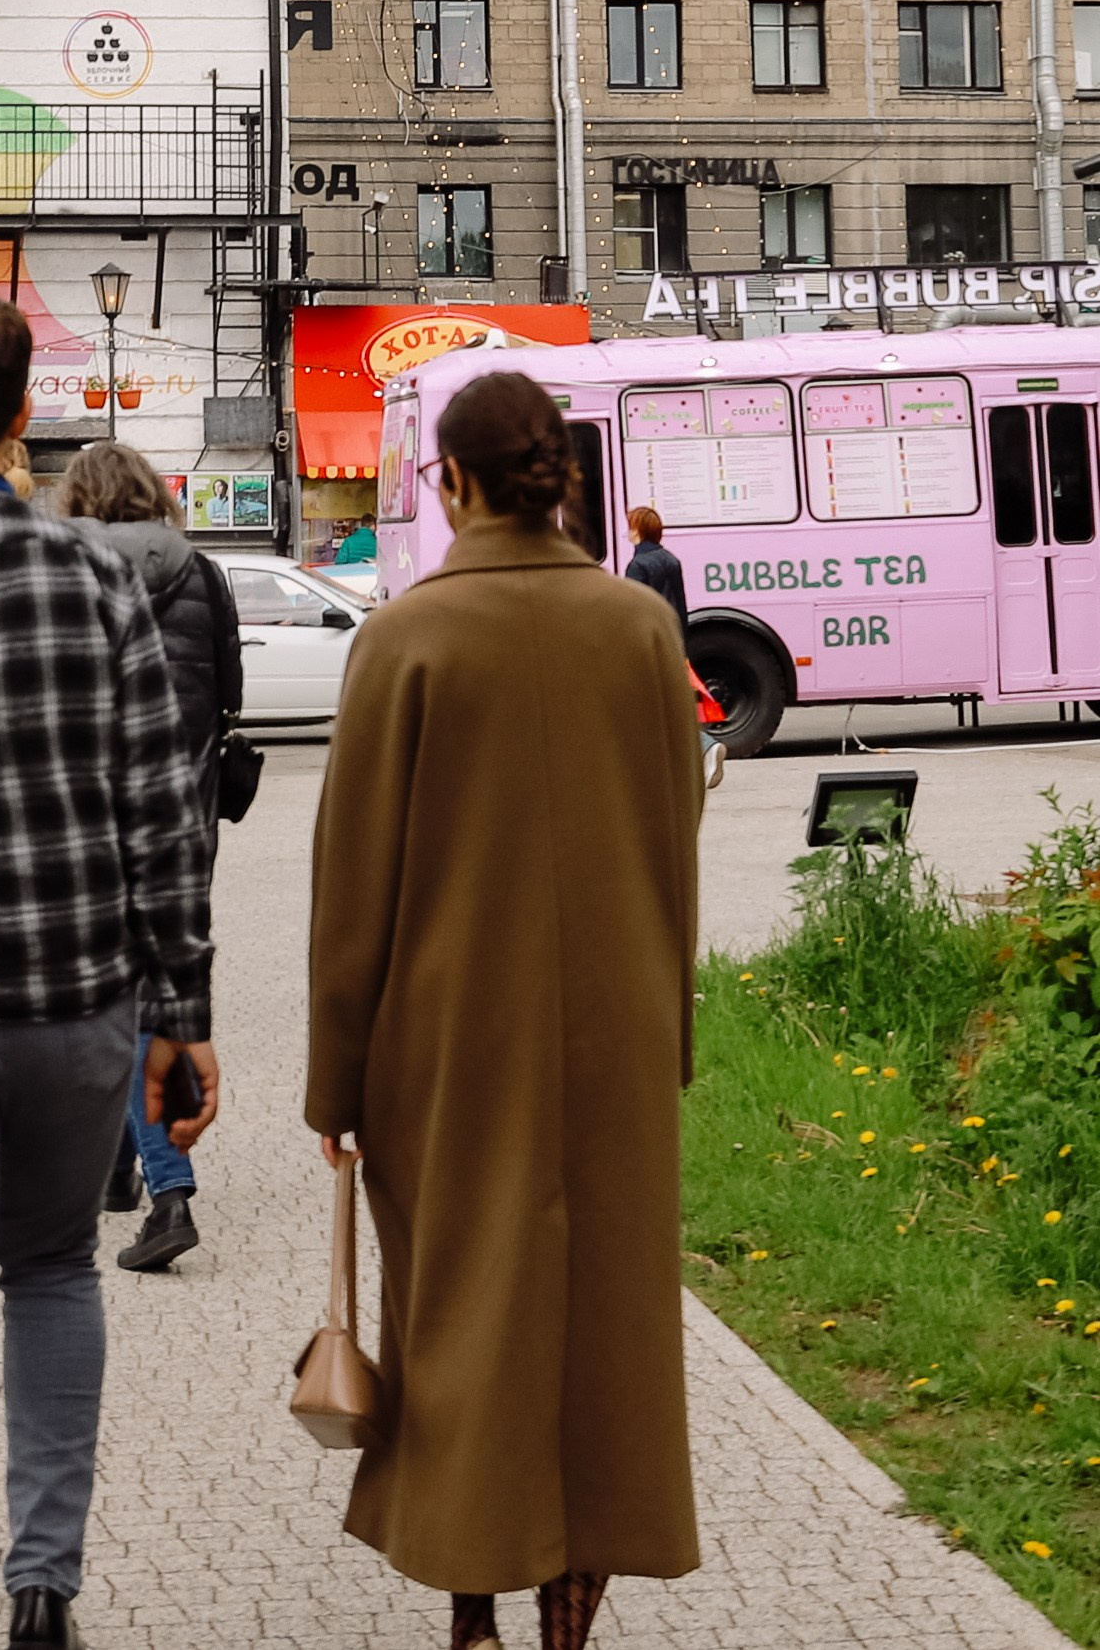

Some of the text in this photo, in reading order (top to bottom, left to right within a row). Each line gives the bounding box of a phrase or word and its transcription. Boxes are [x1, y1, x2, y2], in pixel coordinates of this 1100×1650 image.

[86, 64, 131, 74] ЯБЛОЧНЫЙ
[86, 75, 131, 83] СЕРВИС
[290, 163, 360, 201] ОД
[613, 158, 781, 188] ГОСТИНИЦА
[381, 326, 487, 361] ХОТ-Д
[731, 407, 771, 416] COFFEE
[819, 406, 850, 414] FRUIT
[705, 555, 927, 592] BUBBLE TEA
[823, 615, 891, 648] BAR
